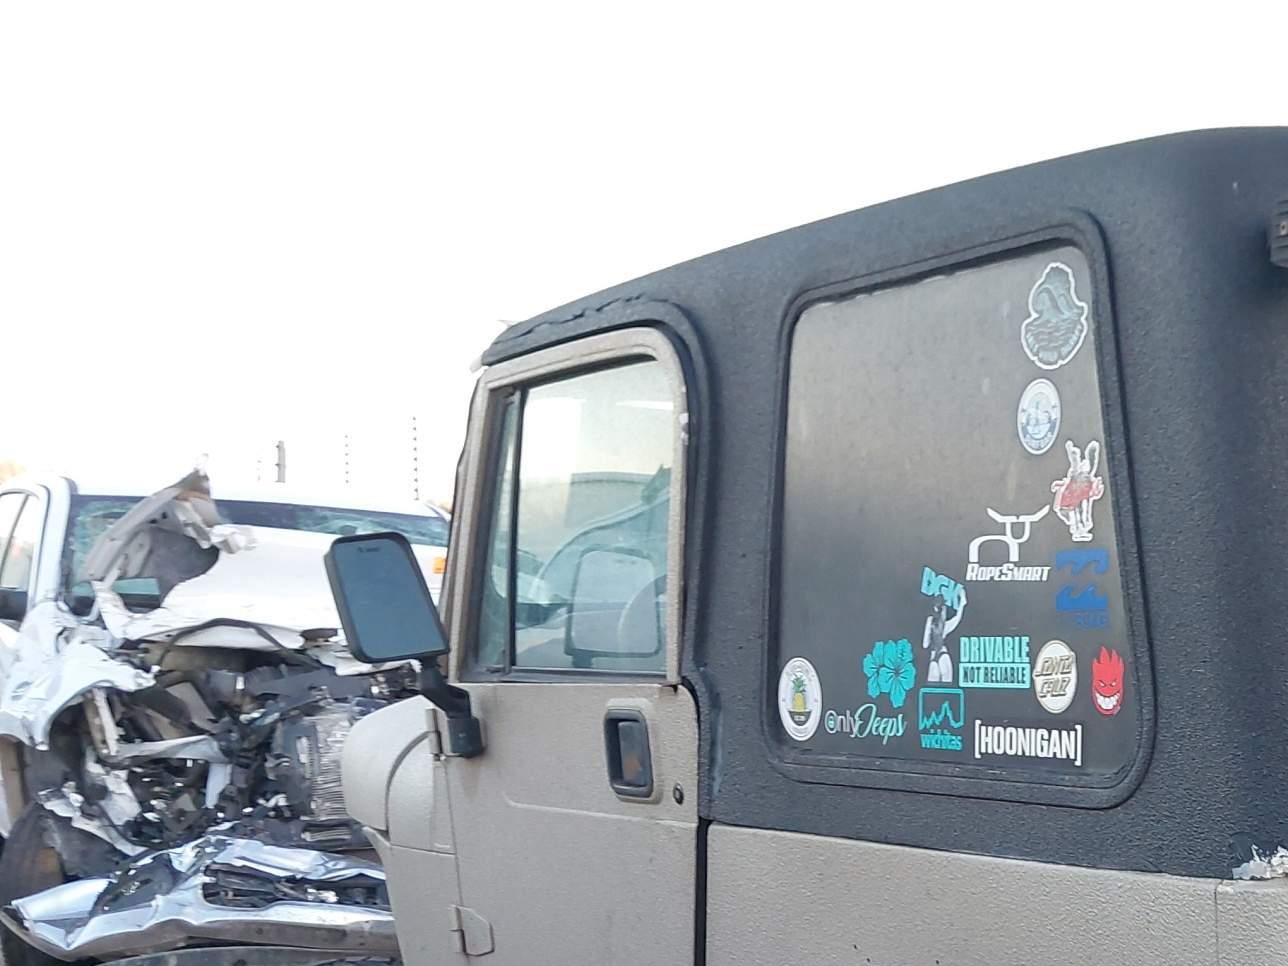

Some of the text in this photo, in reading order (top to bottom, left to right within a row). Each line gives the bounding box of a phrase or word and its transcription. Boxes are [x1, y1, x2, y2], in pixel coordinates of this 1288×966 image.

[960, 636, 1030, 662] DRIVABLE
[962, 666, 1026, 684] NOT RELIABLE
